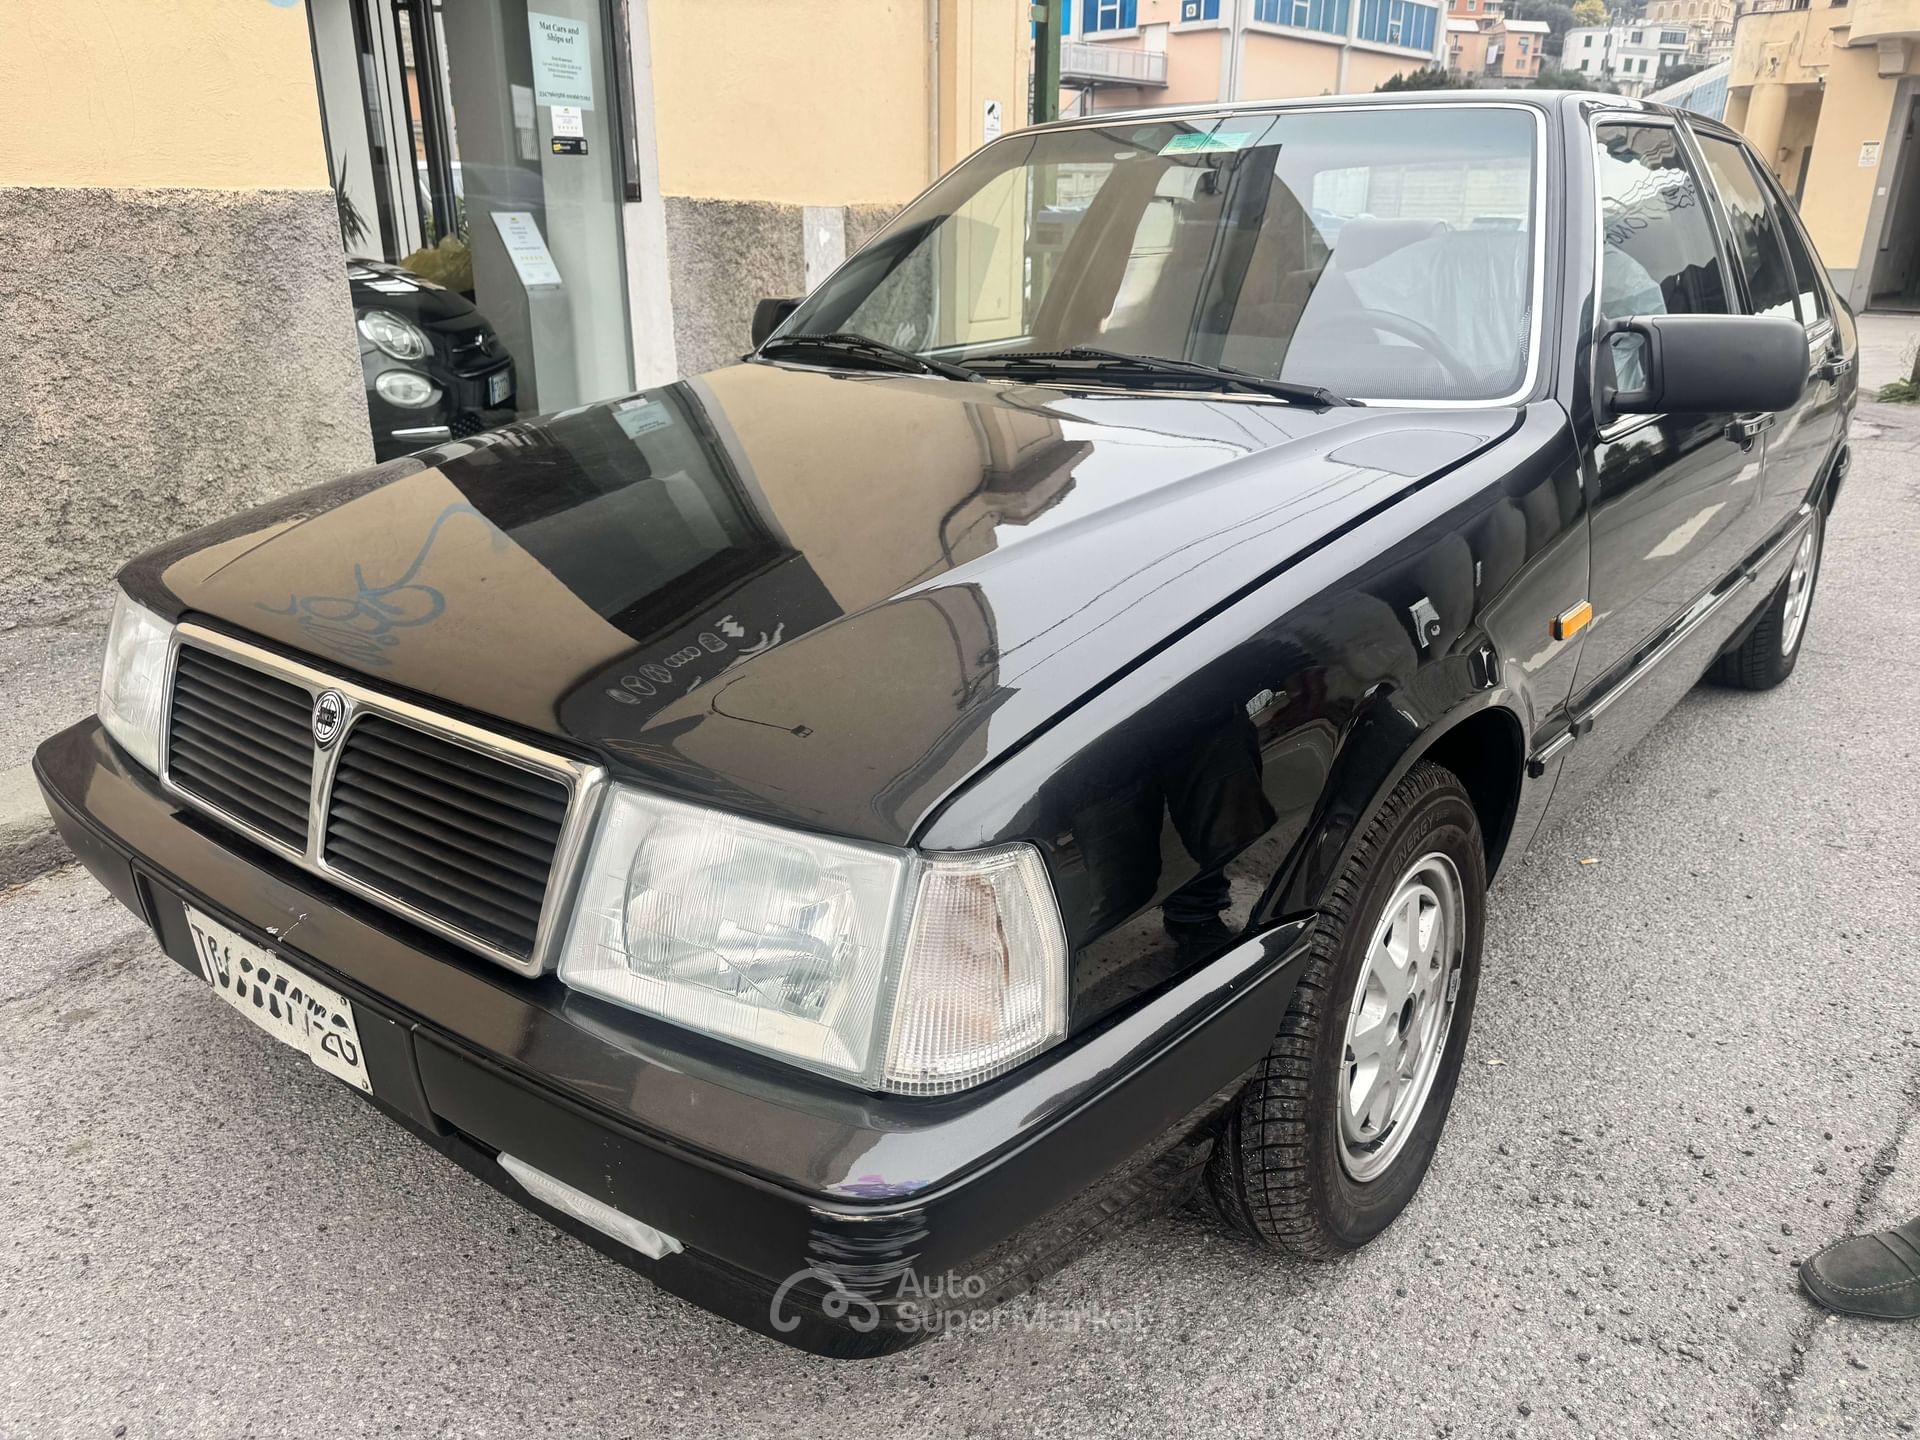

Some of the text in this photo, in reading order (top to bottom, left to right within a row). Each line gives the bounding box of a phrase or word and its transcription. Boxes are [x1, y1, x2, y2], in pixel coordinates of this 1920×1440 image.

[539, 21, 580, 35] Mat Cars and
[547, 33, 574, 45] Ships srl
[1391, 811, 1434, 875] ENERGY
